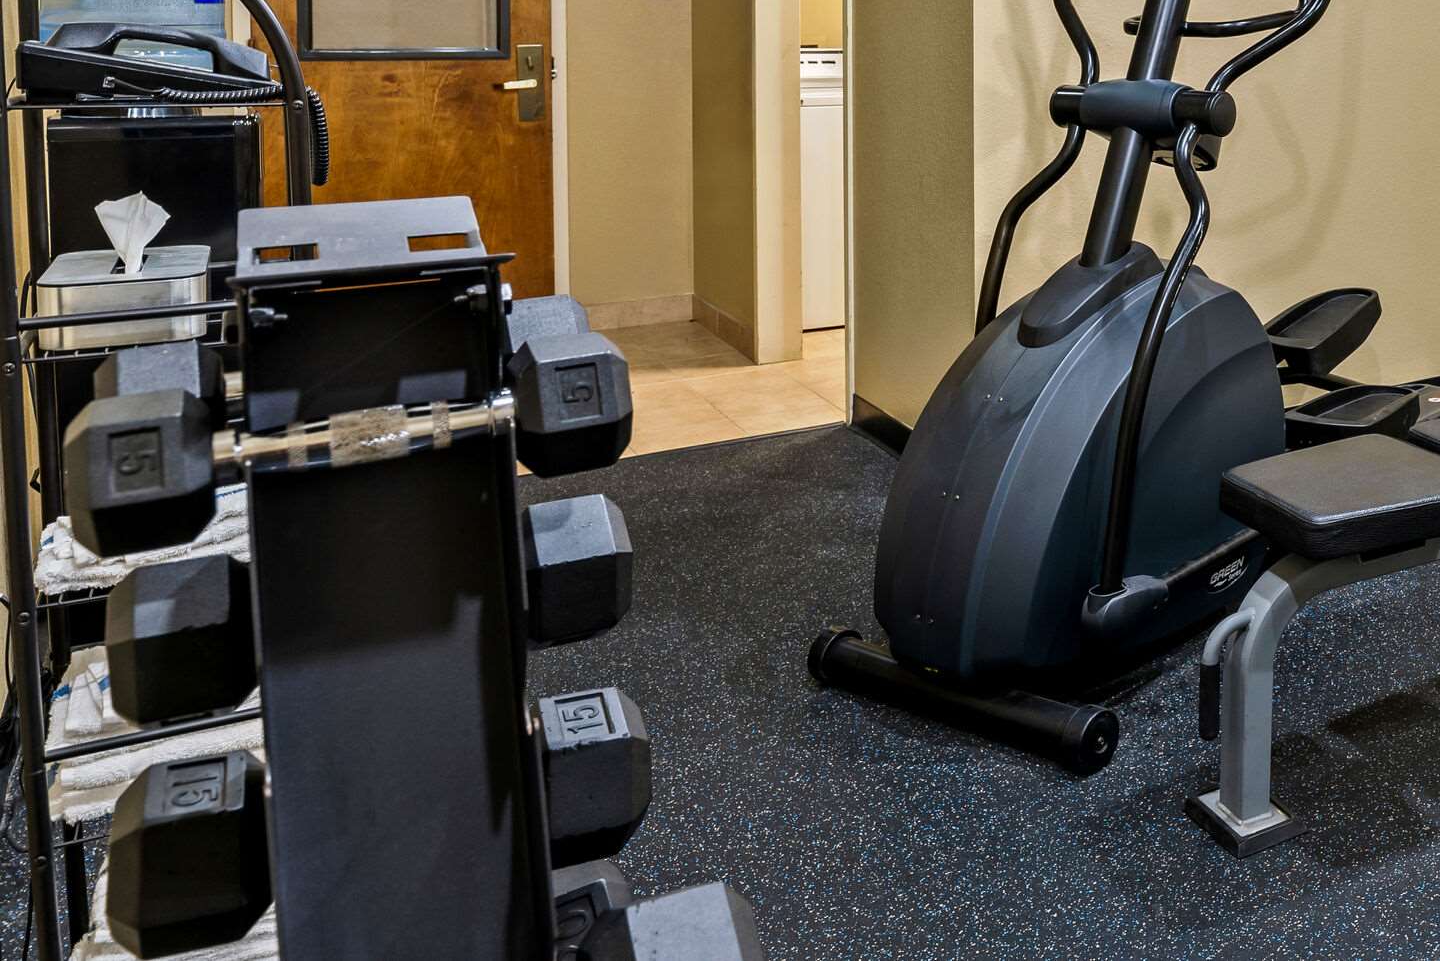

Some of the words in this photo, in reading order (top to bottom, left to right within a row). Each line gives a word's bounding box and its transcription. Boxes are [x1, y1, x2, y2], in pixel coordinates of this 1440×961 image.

[561, 381, 595, 404] 5
[115, 449, 159, 477] 5
[1210, 555, 1245, 584] GREEN
[561, 704, 604, 735] 15
[170, 775, 220, 808] 15
